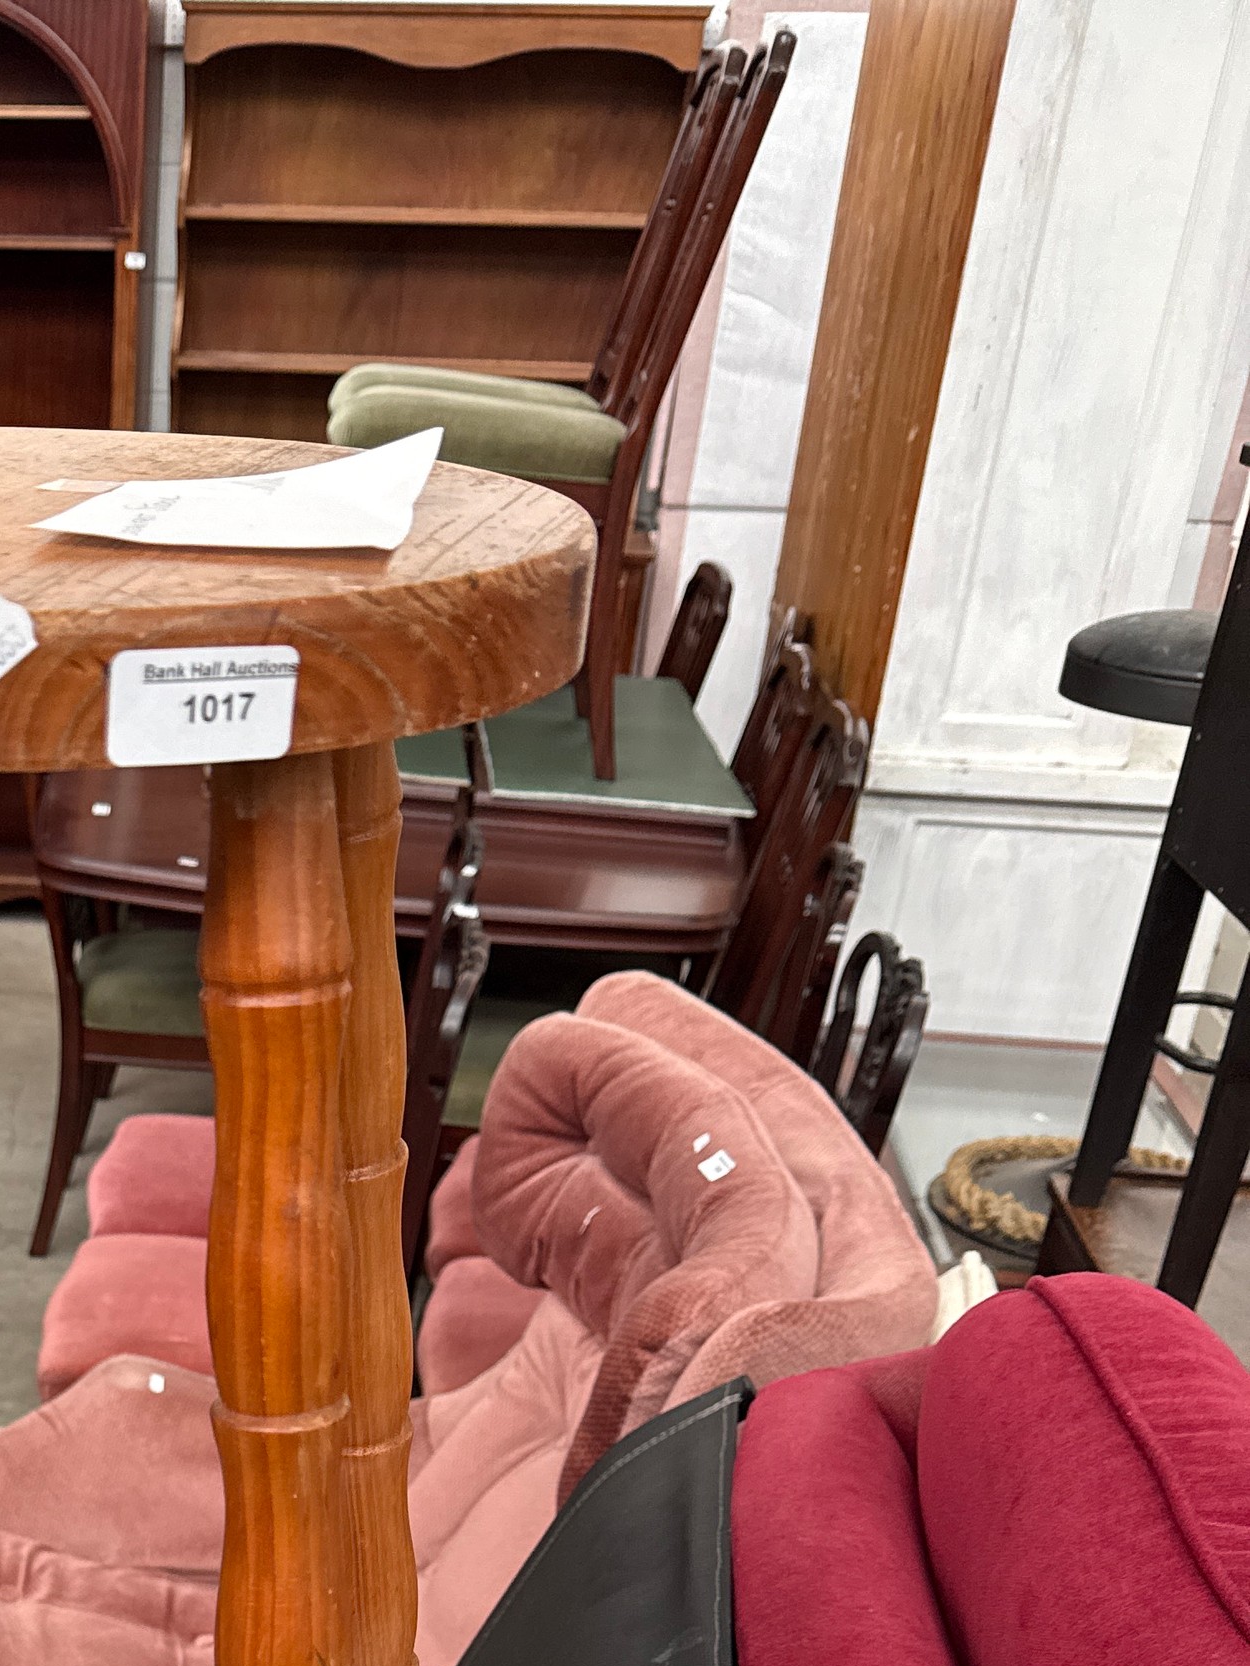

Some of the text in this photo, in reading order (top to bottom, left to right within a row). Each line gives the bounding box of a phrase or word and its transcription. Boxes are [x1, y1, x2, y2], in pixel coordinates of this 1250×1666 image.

[143, 659, 299, 679] Bank Hall Auctions
[183, 692, 256, 724] 1017
